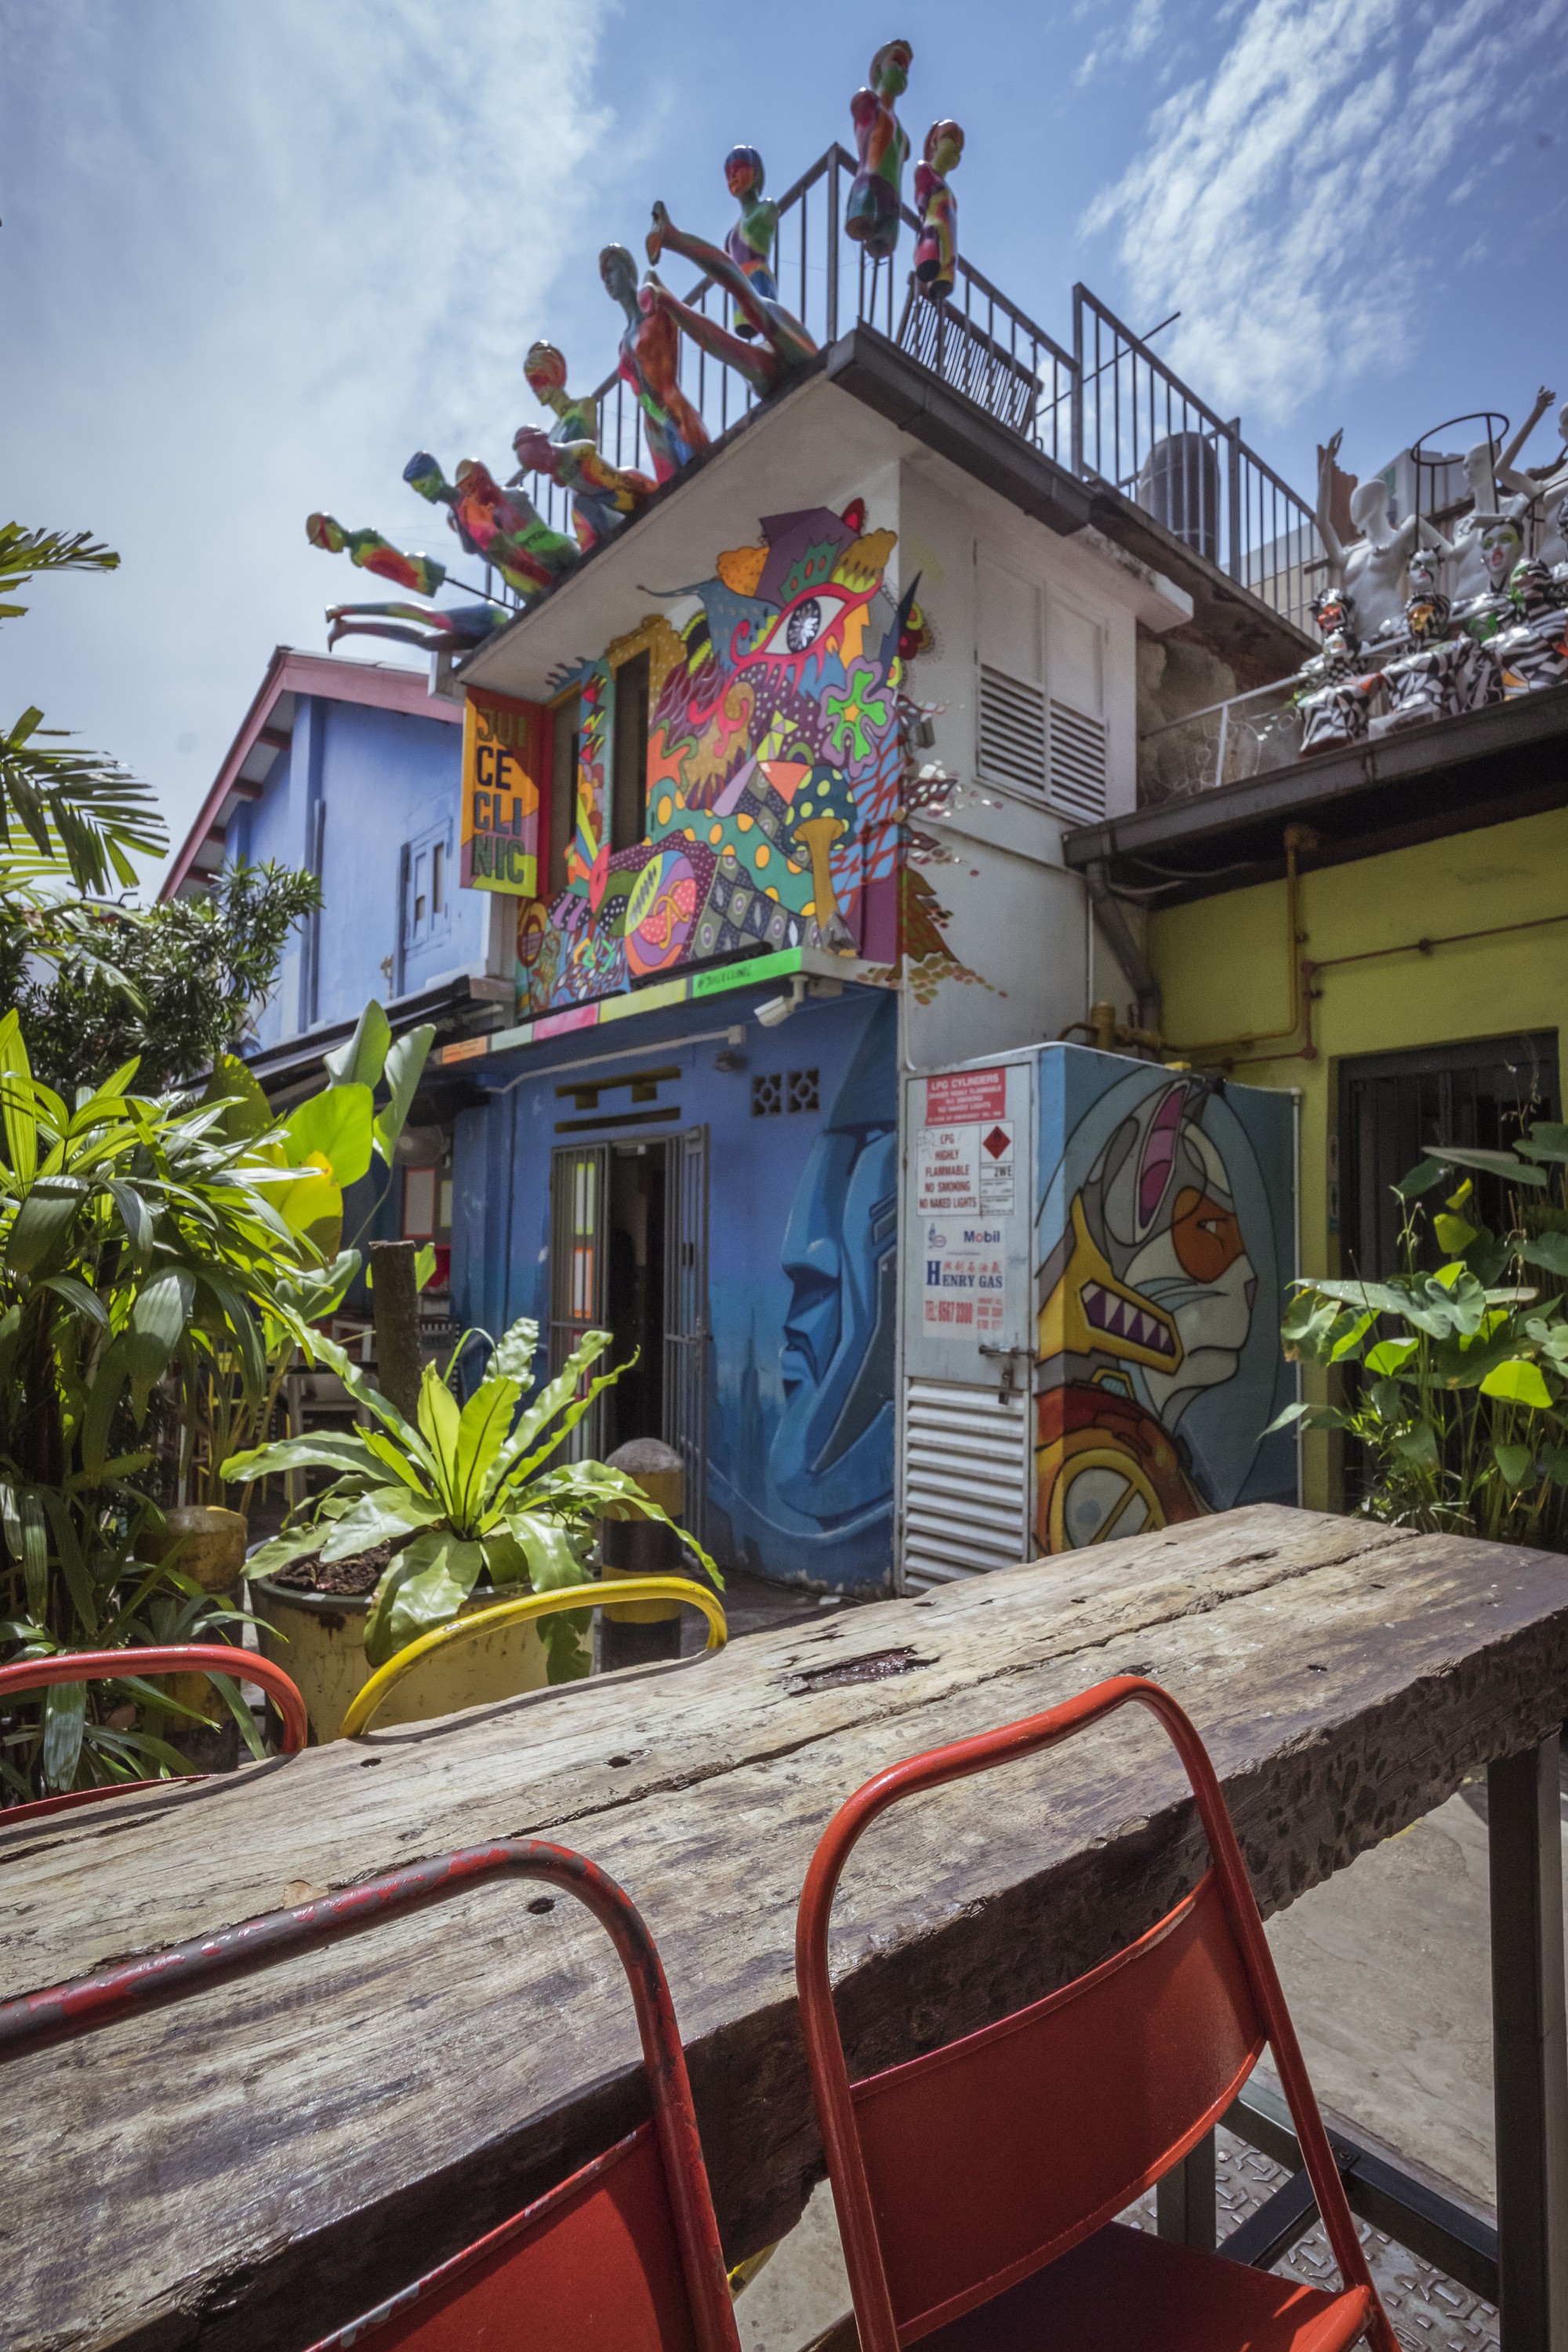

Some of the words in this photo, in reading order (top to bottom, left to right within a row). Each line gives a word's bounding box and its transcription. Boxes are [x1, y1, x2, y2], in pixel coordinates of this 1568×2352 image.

[476, 707, 528, 749] JUI
[476, 746, 514, 790] CE
[474, 790, 523, 837] CLI
[472, 833, 526, 884] NIC
[931, 1080, 949, 1091] LPG
[951, 1073, 1000, 1088] CYLINDERS
[935, 1149, 960, 1160] HIGHLY
[925, 1164, 970, 1178] FLAMMABLE
[995, 1165, 1012, 1177] 2WE
[924, 1181, 935, 1192] NO
[938, 1181, 971, 1192] SMOKING
[919, 1198, 928, 1209] NO
[930, 1197, 952, 1208] NAKED
[953, 1196, 977, 1208] LIGHTS
[964, 1230, 1000, 1243] Mobil
[927, 1260, 976, 1287] HENRY
[978, 1275, 1003, 1289] GAS
